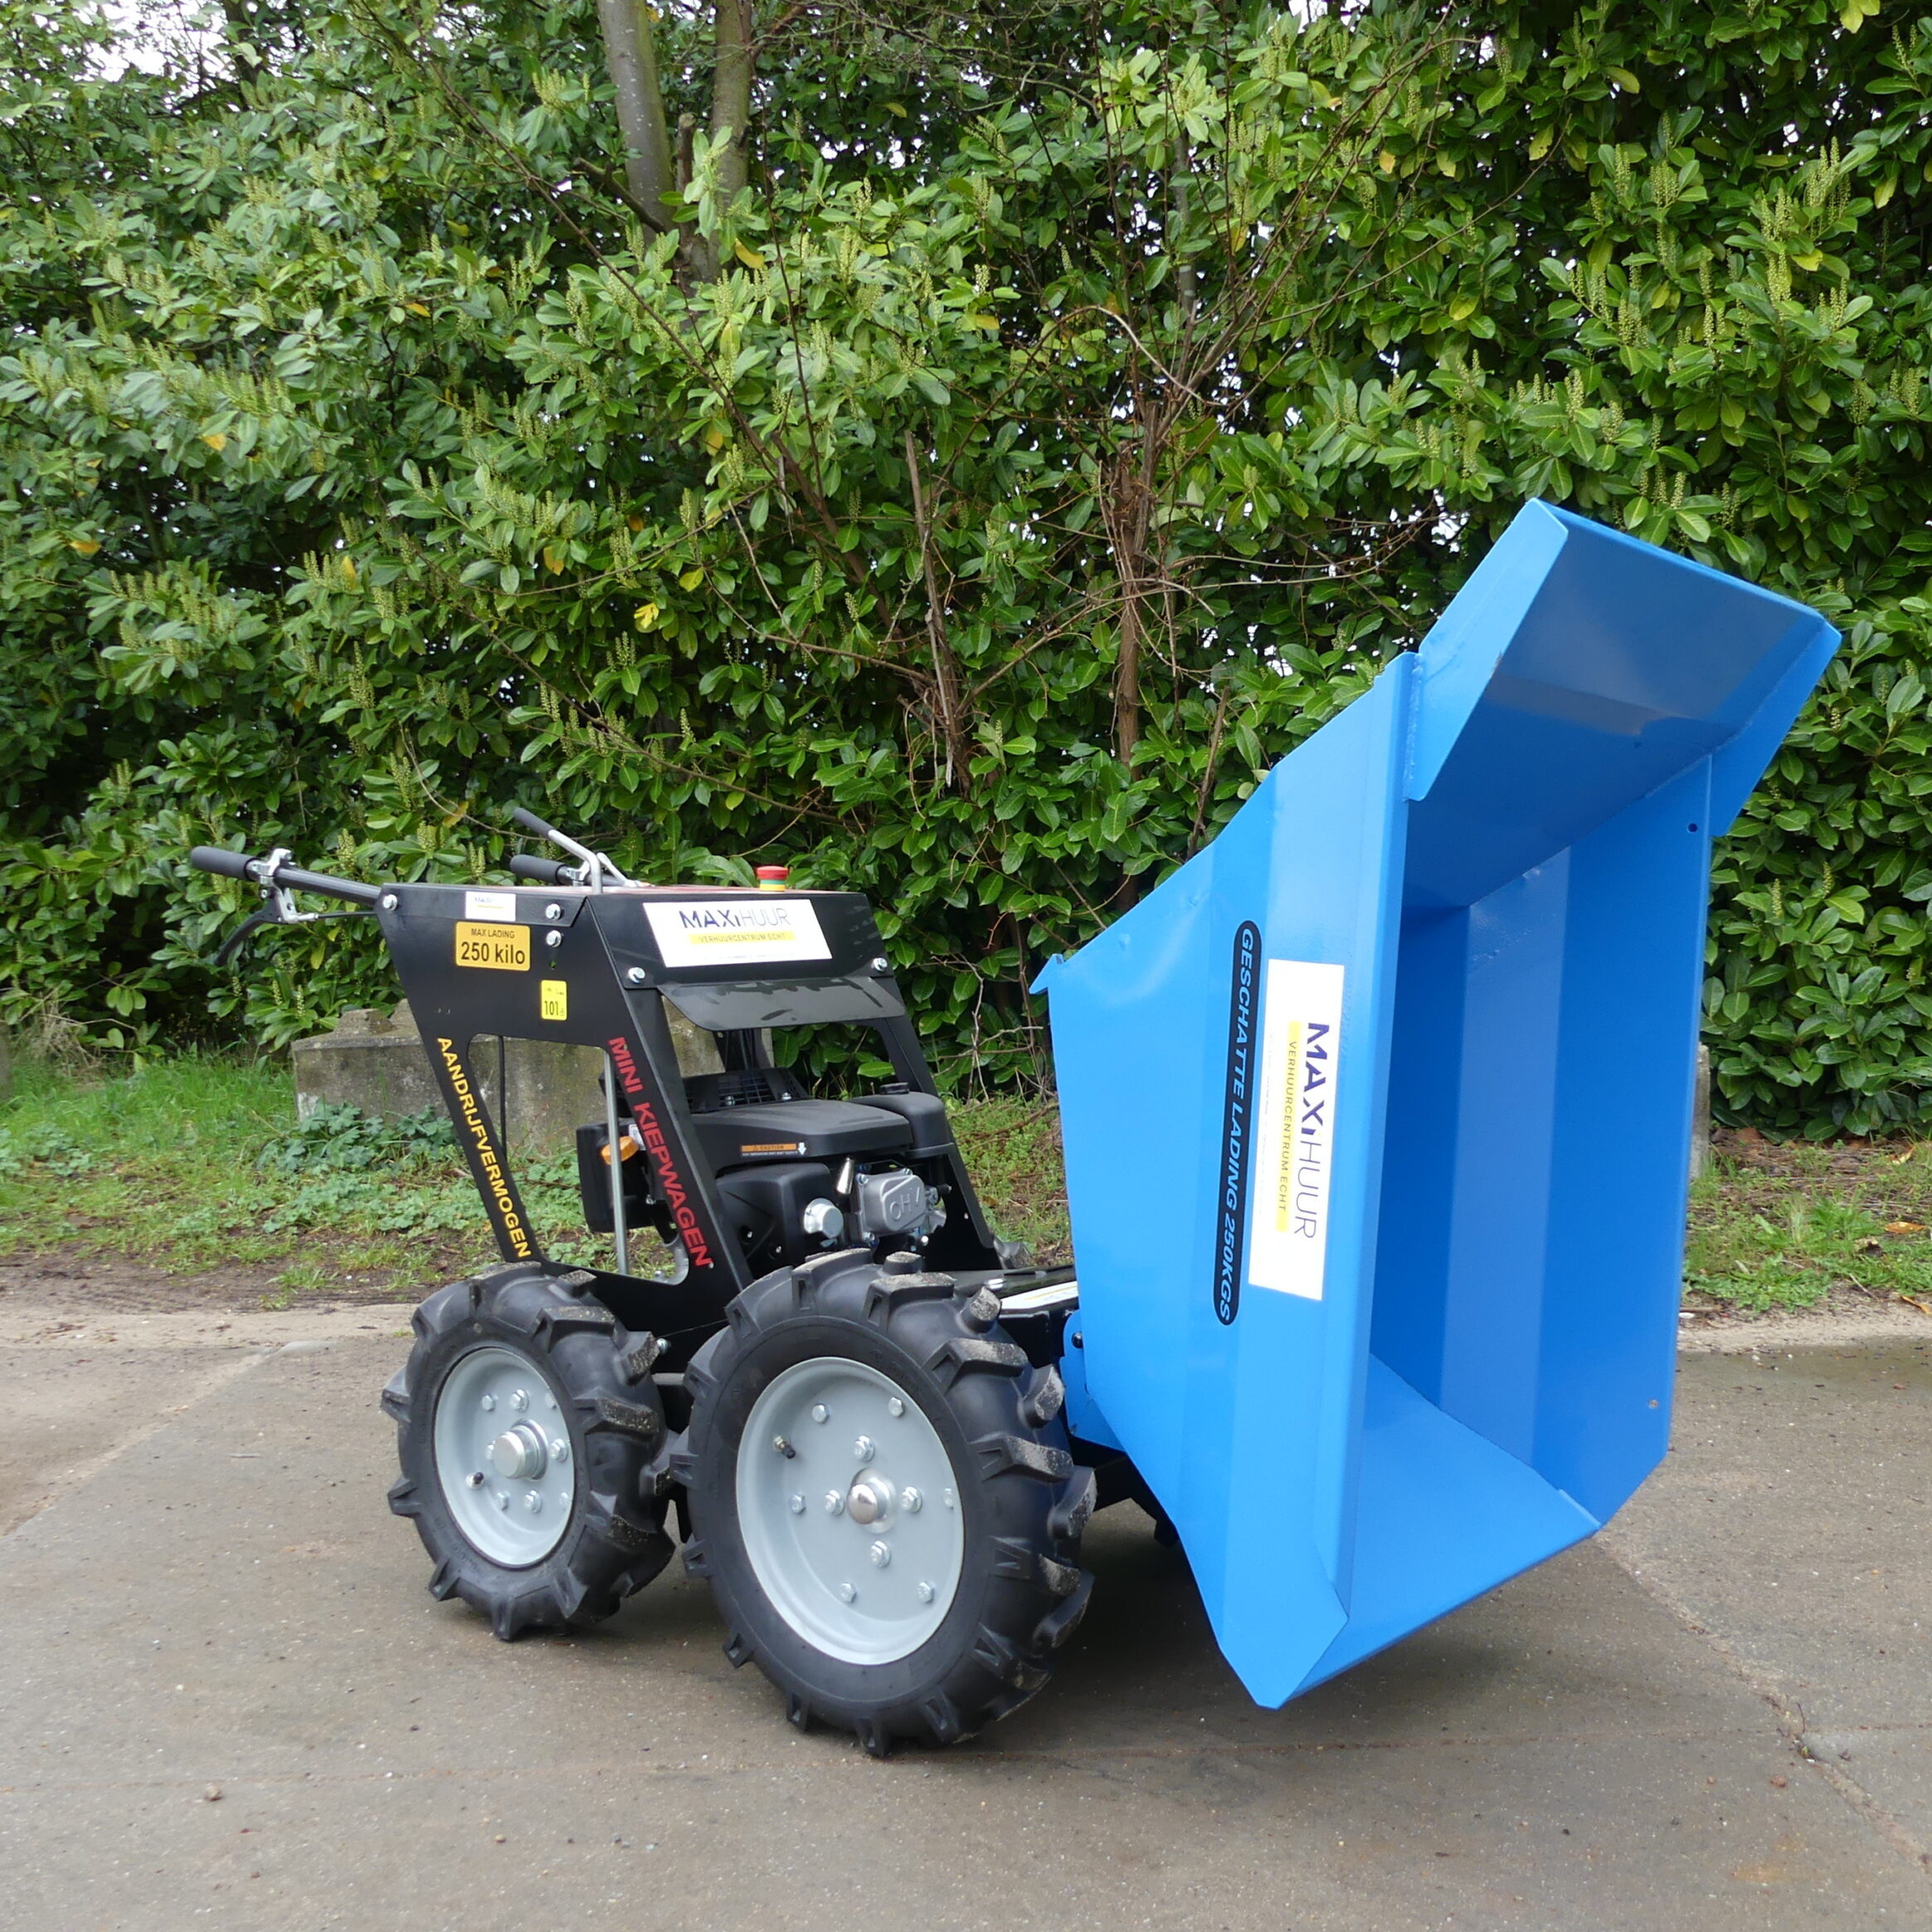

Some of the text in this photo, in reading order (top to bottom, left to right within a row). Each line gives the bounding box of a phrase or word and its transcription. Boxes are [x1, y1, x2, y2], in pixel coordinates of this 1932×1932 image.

[461, 942, 525, 964] 250 kilo
[471, 928, 514, 938] MAX LADING
[698, 934, 766, 942] VERHUURCENTRUM
[436, 1037, 531, 1258] AANDRIJFVERMOGEN
[608, 1036, 713, 1268] MINI KIEPWAGEN
[1220, 928, 1253, 1321] GESCHATTE LADING 250KGS
[1278, 1041, 1297, 1211] VERHUURCENTRUM ECHT
